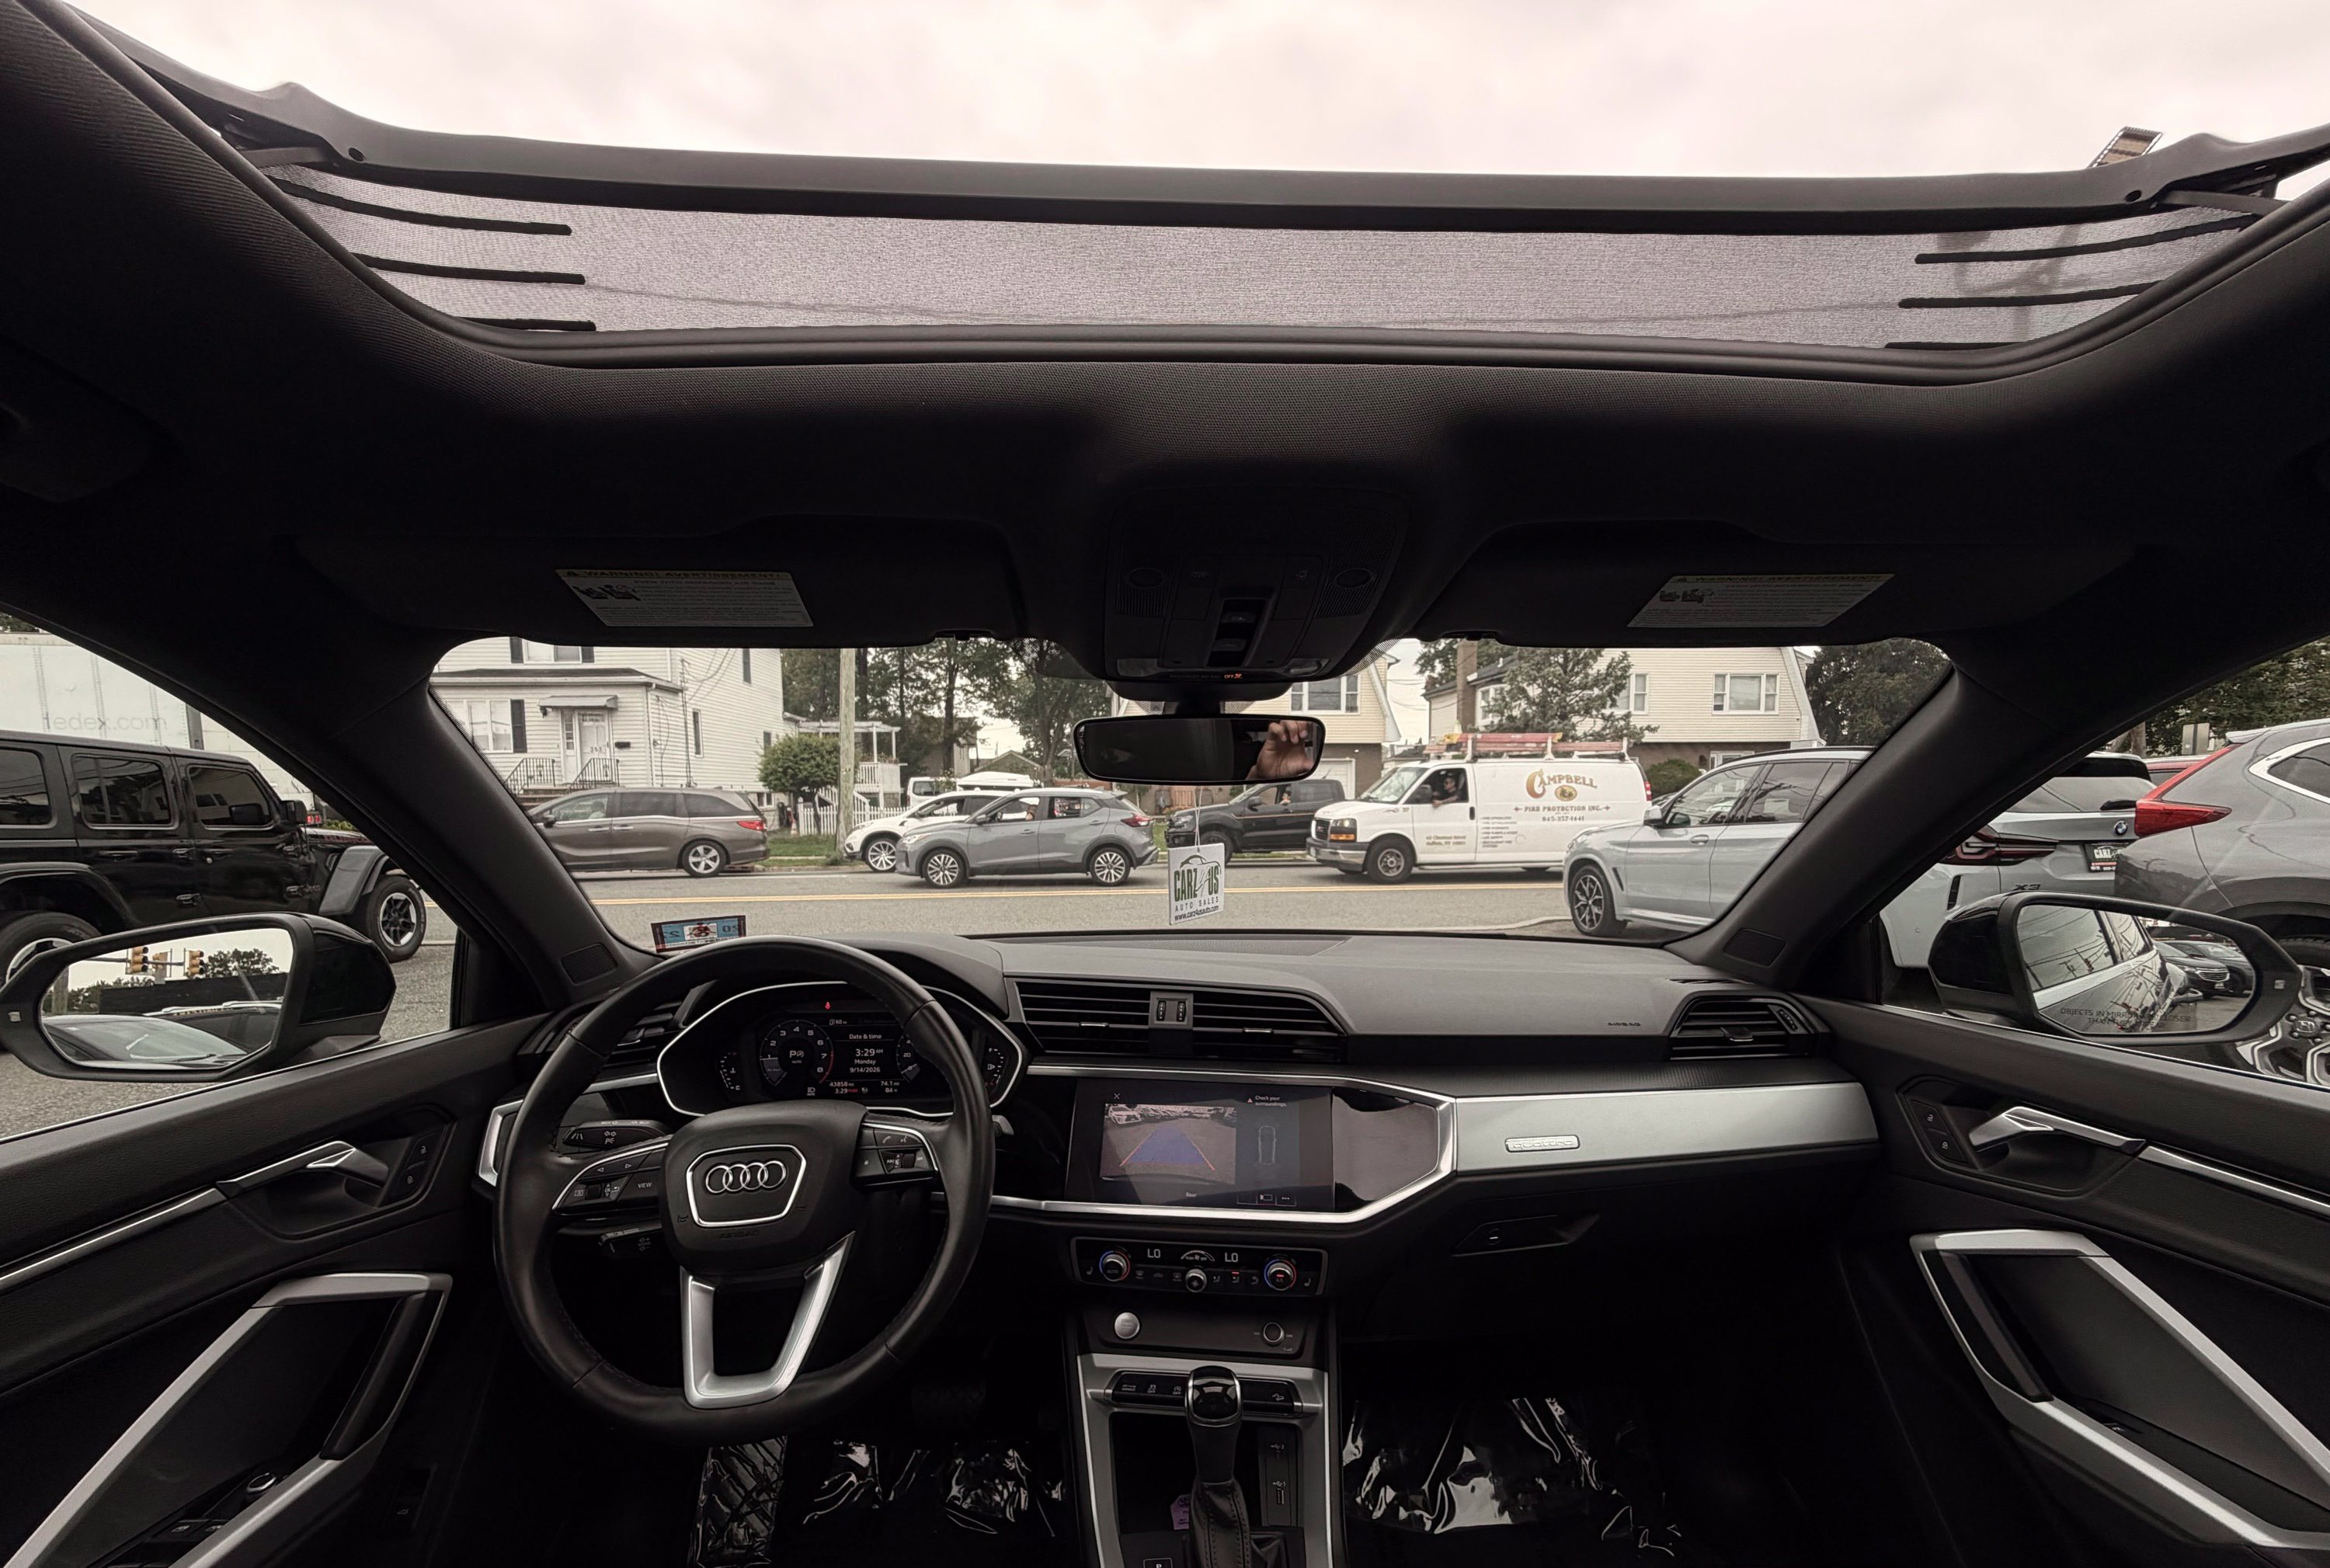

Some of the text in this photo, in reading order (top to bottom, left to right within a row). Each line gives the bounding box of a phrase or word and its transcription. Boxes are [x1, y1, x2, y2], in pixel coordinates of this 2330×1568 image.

[1526, 769, 1597, 798] CAMPBELL
[1175, 896, 1219, 912] AUTO SALES
[789, 1050, 797, 1059] P
[855, 1048, 875, 1057] 3:29
[1146, 1248, 1161, 1259] LO
[1224, 1252, 1239, 1263] LO
